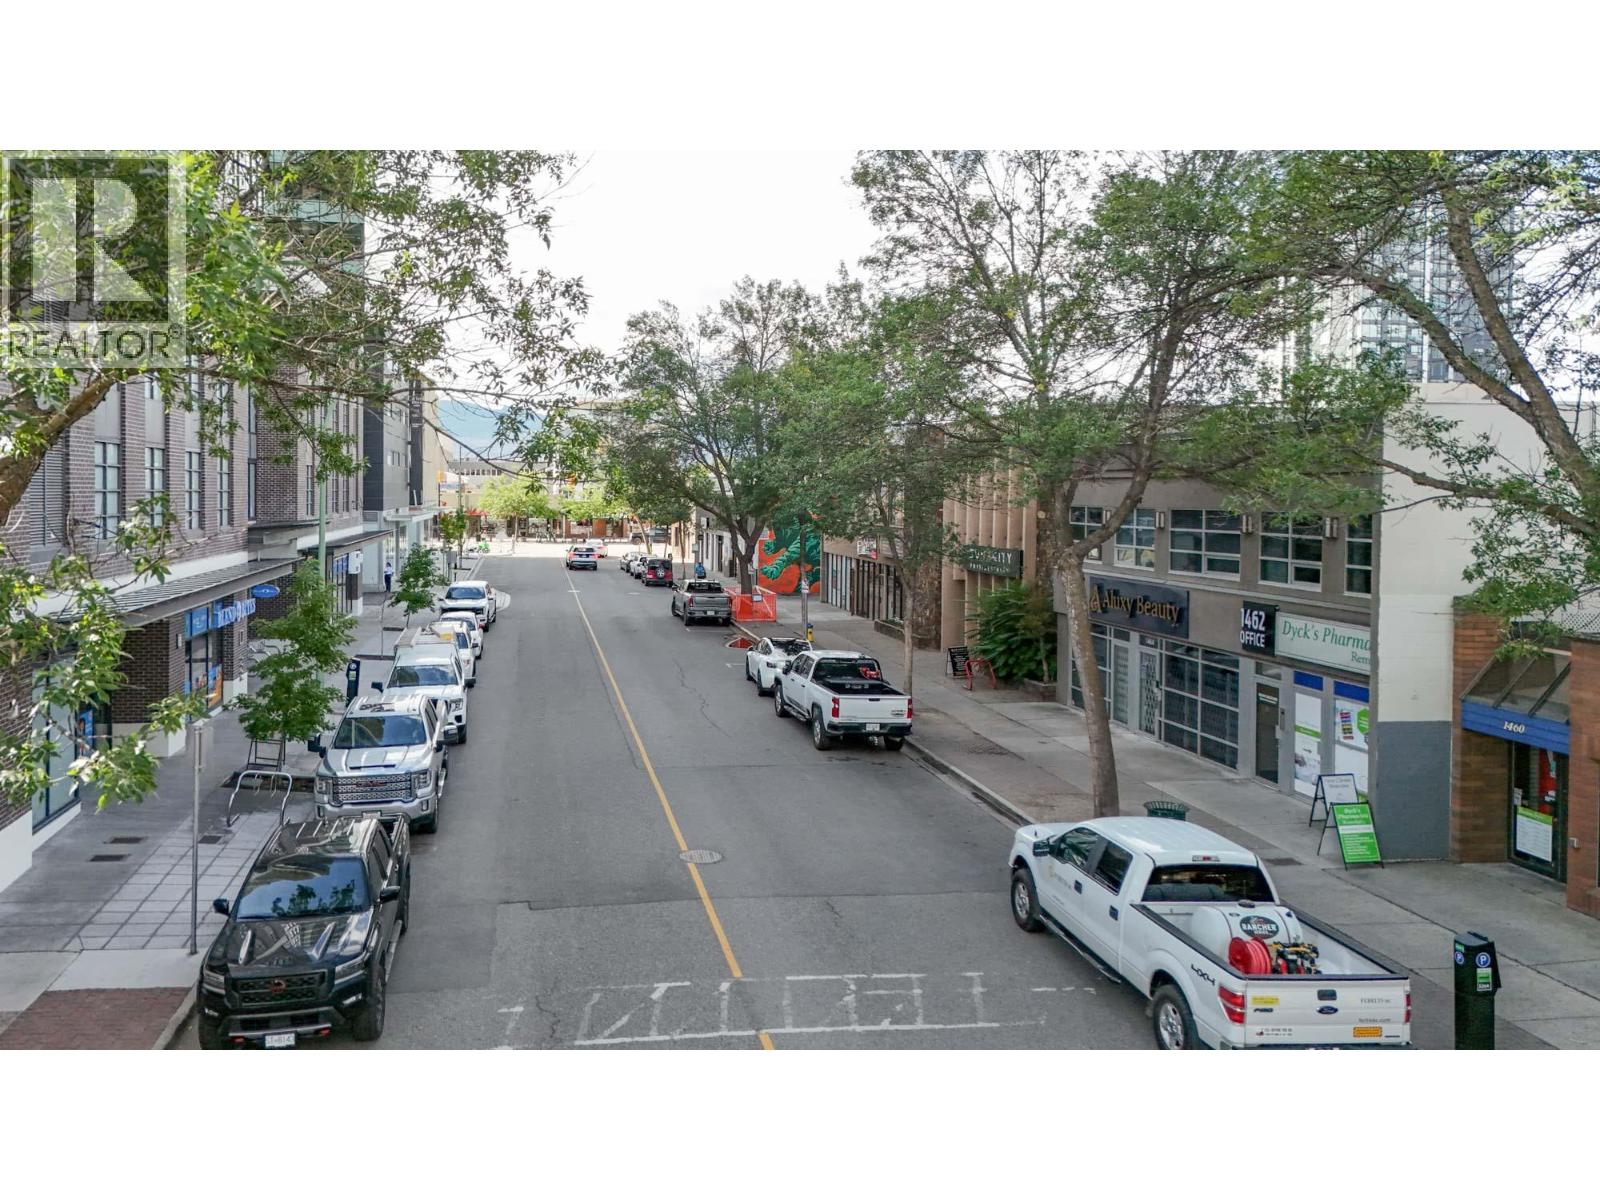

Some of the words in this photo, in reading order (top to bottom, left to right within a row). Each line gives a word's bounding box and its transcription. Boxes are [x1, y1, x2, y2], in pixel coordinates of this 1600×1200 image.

[1103, 589, 1134, 619] Aluxy
[1136, 595, 1180, 627] Beauty
[1240, 607, 1265, 631] 1462
[1240, 630, 1265, 648] OFFICE
[1282, 619, 1319, 641] Dyck's
[1503, 720, 1525, 734] 1460
